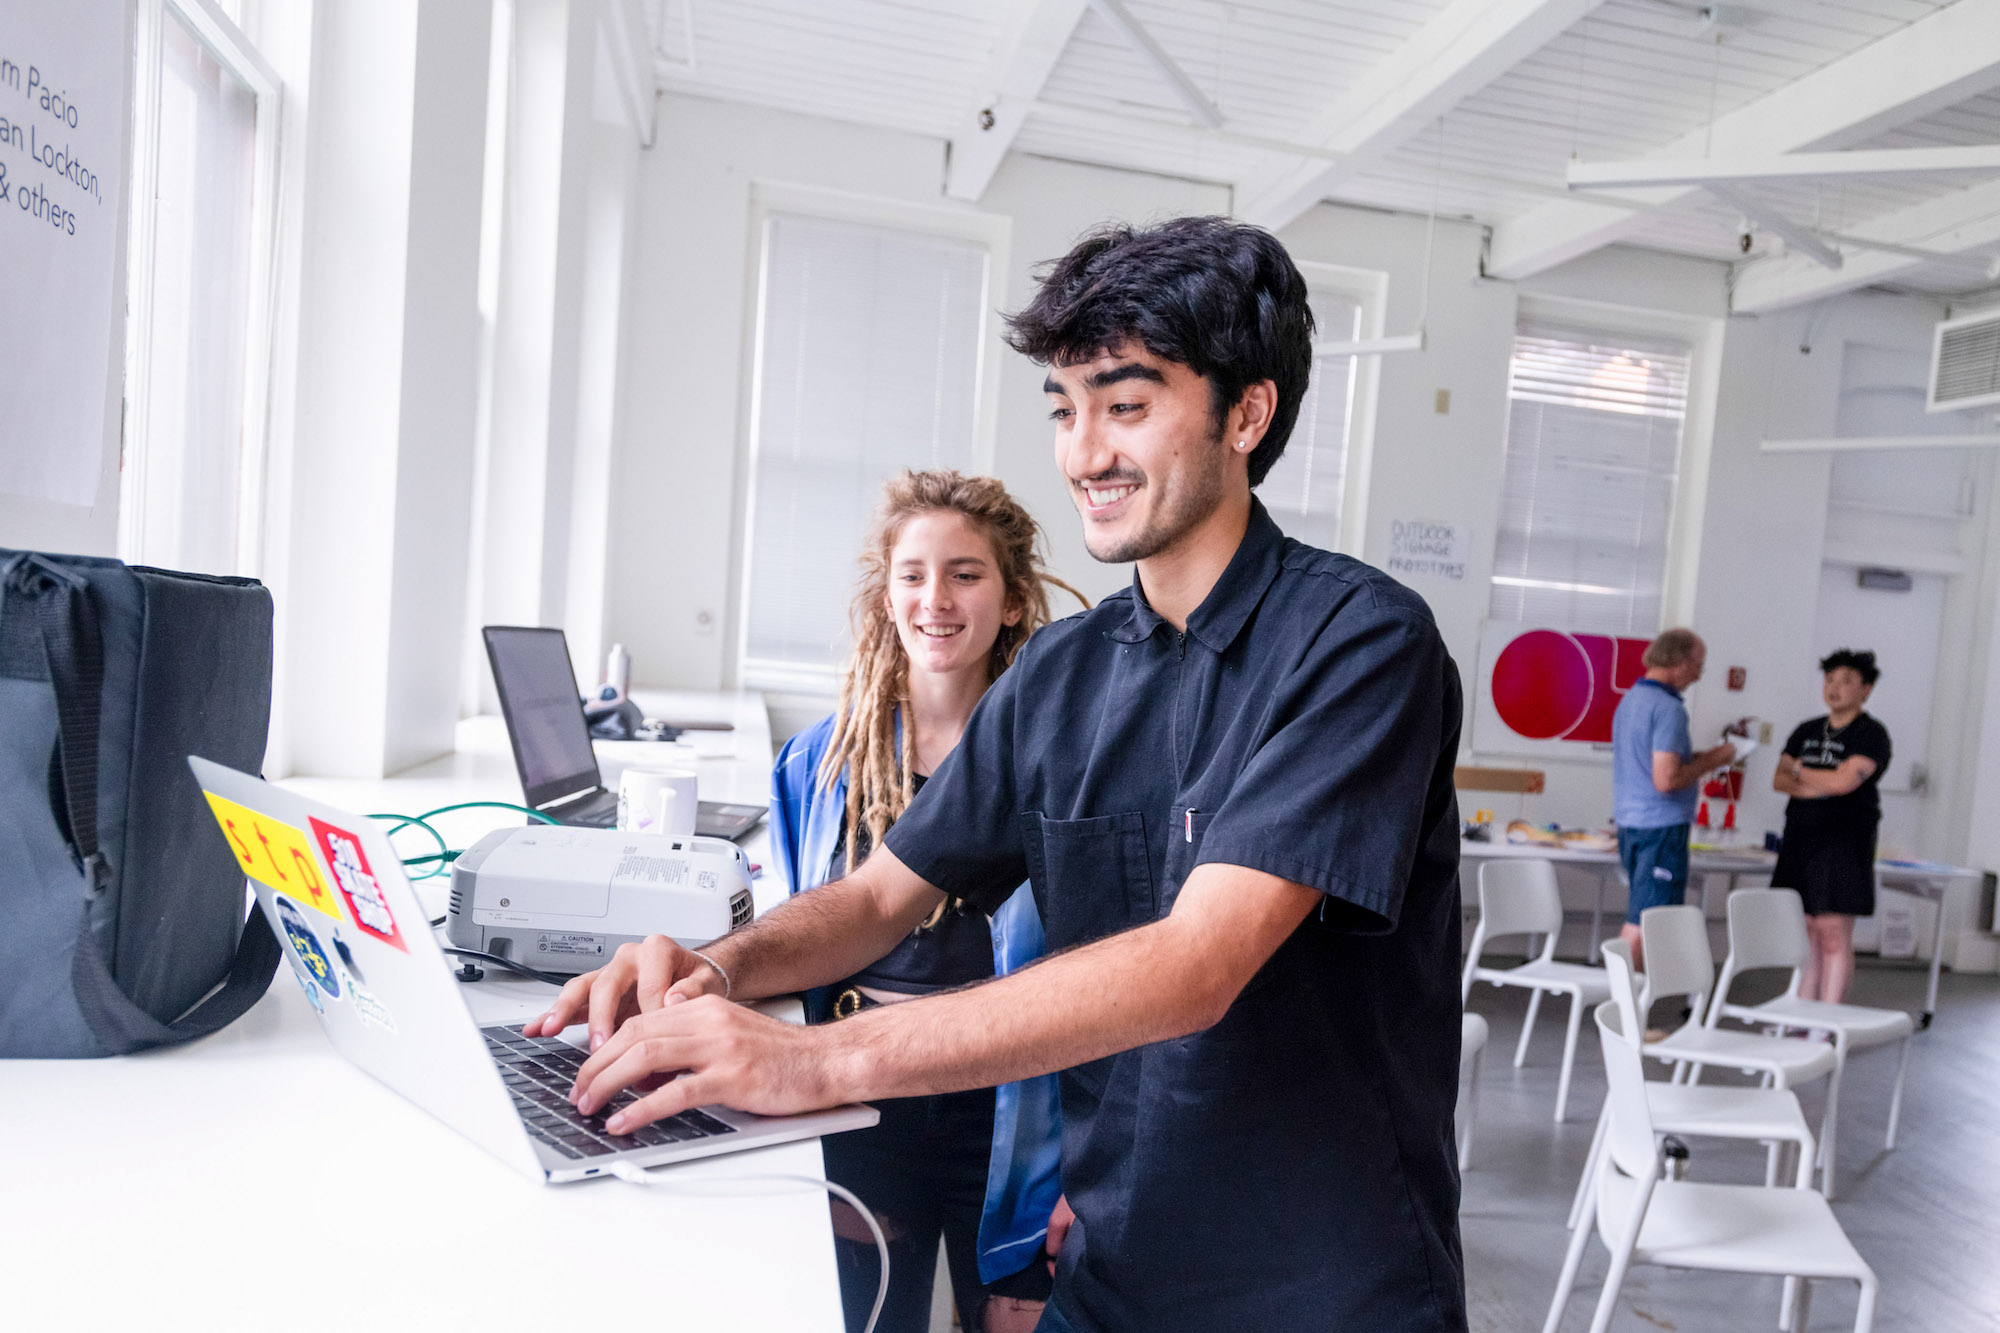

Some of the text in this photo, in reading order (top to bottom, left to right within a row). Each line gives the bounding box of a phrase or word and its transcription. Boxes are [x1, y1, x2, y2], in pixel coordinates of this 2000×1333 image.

[27, 65, 78, 129] Pacio
[0, 117, 102, 206] an Lockton,
[18, 182, 76, 236] others
